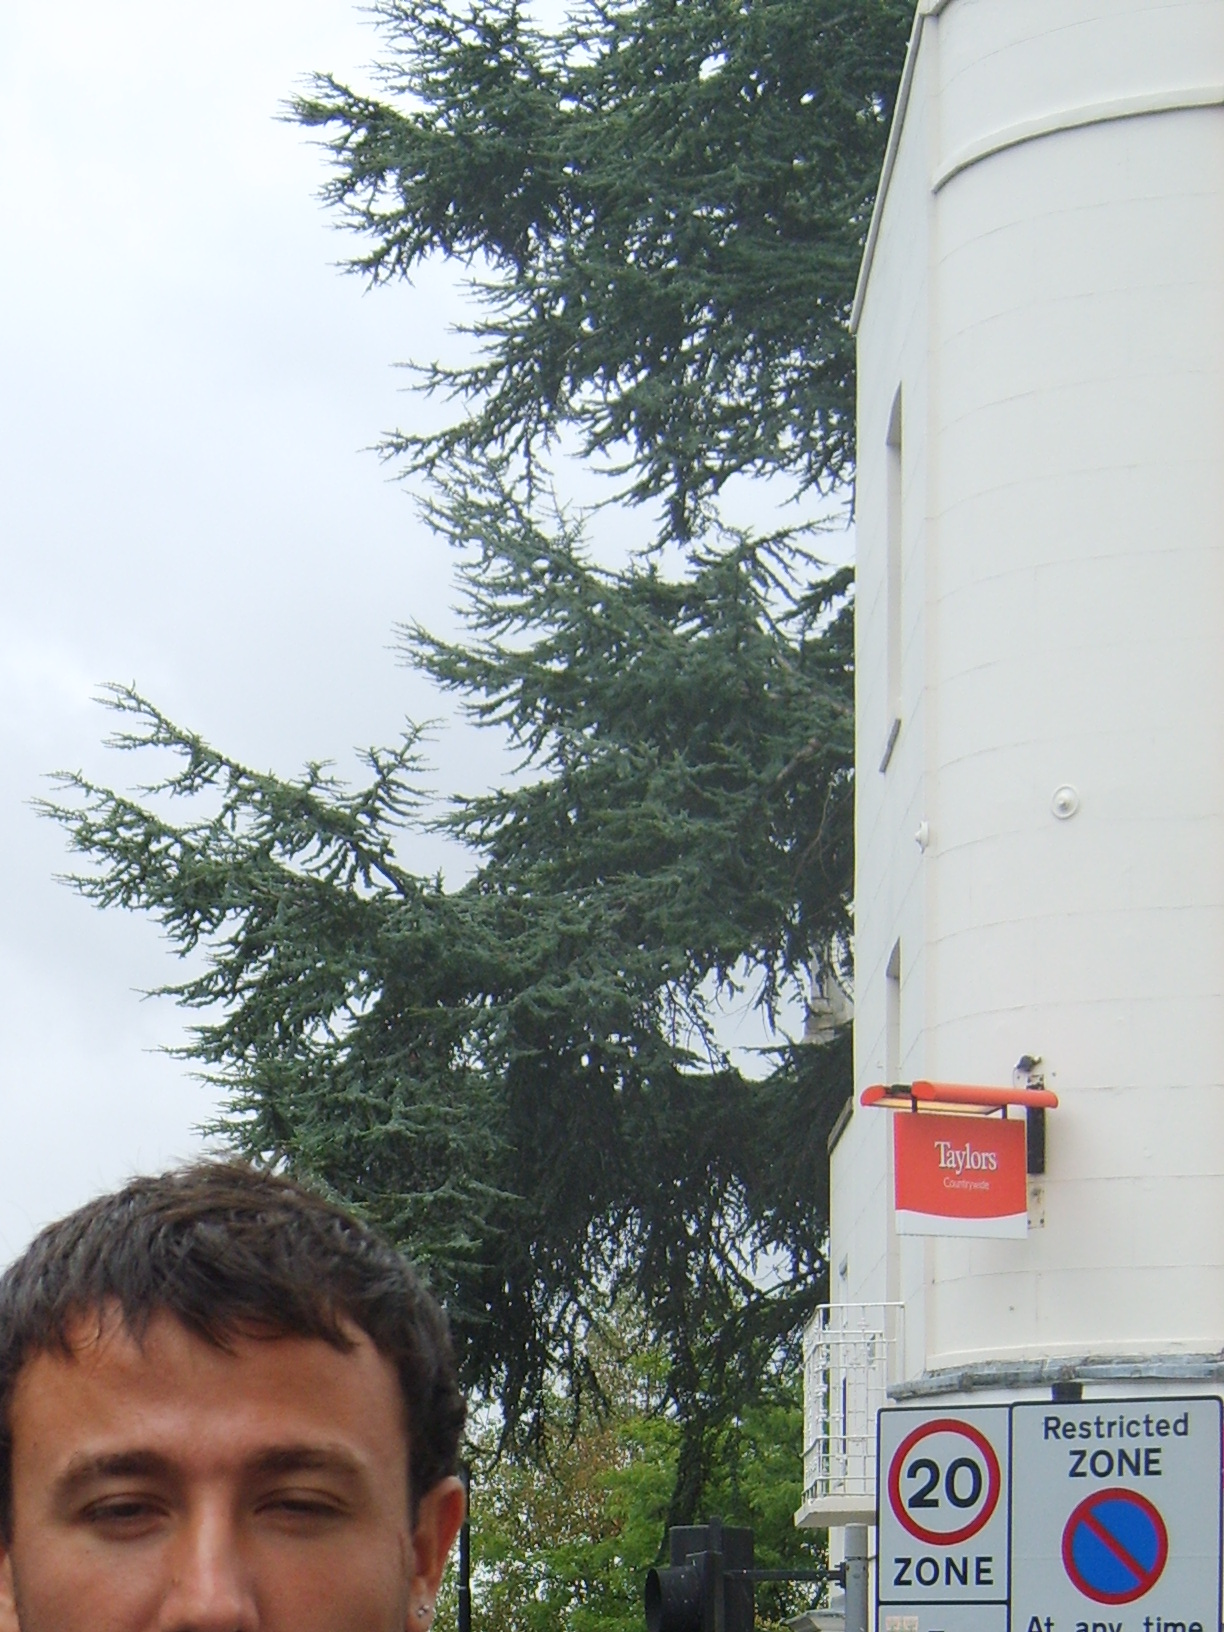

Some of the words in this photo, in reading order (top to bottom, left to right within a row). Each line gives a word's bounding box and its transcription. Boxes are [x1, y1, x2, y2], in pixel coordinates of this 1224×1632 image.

[934, 1140, 998, 1175] Taylors
[1043, 1412, 1189, 1440] Restricted
[1068, 1448, 1162, 1477] ZONE
[906, 1457, 983, 1508] 20
[893, 1556, 994, 1587] ZONE
